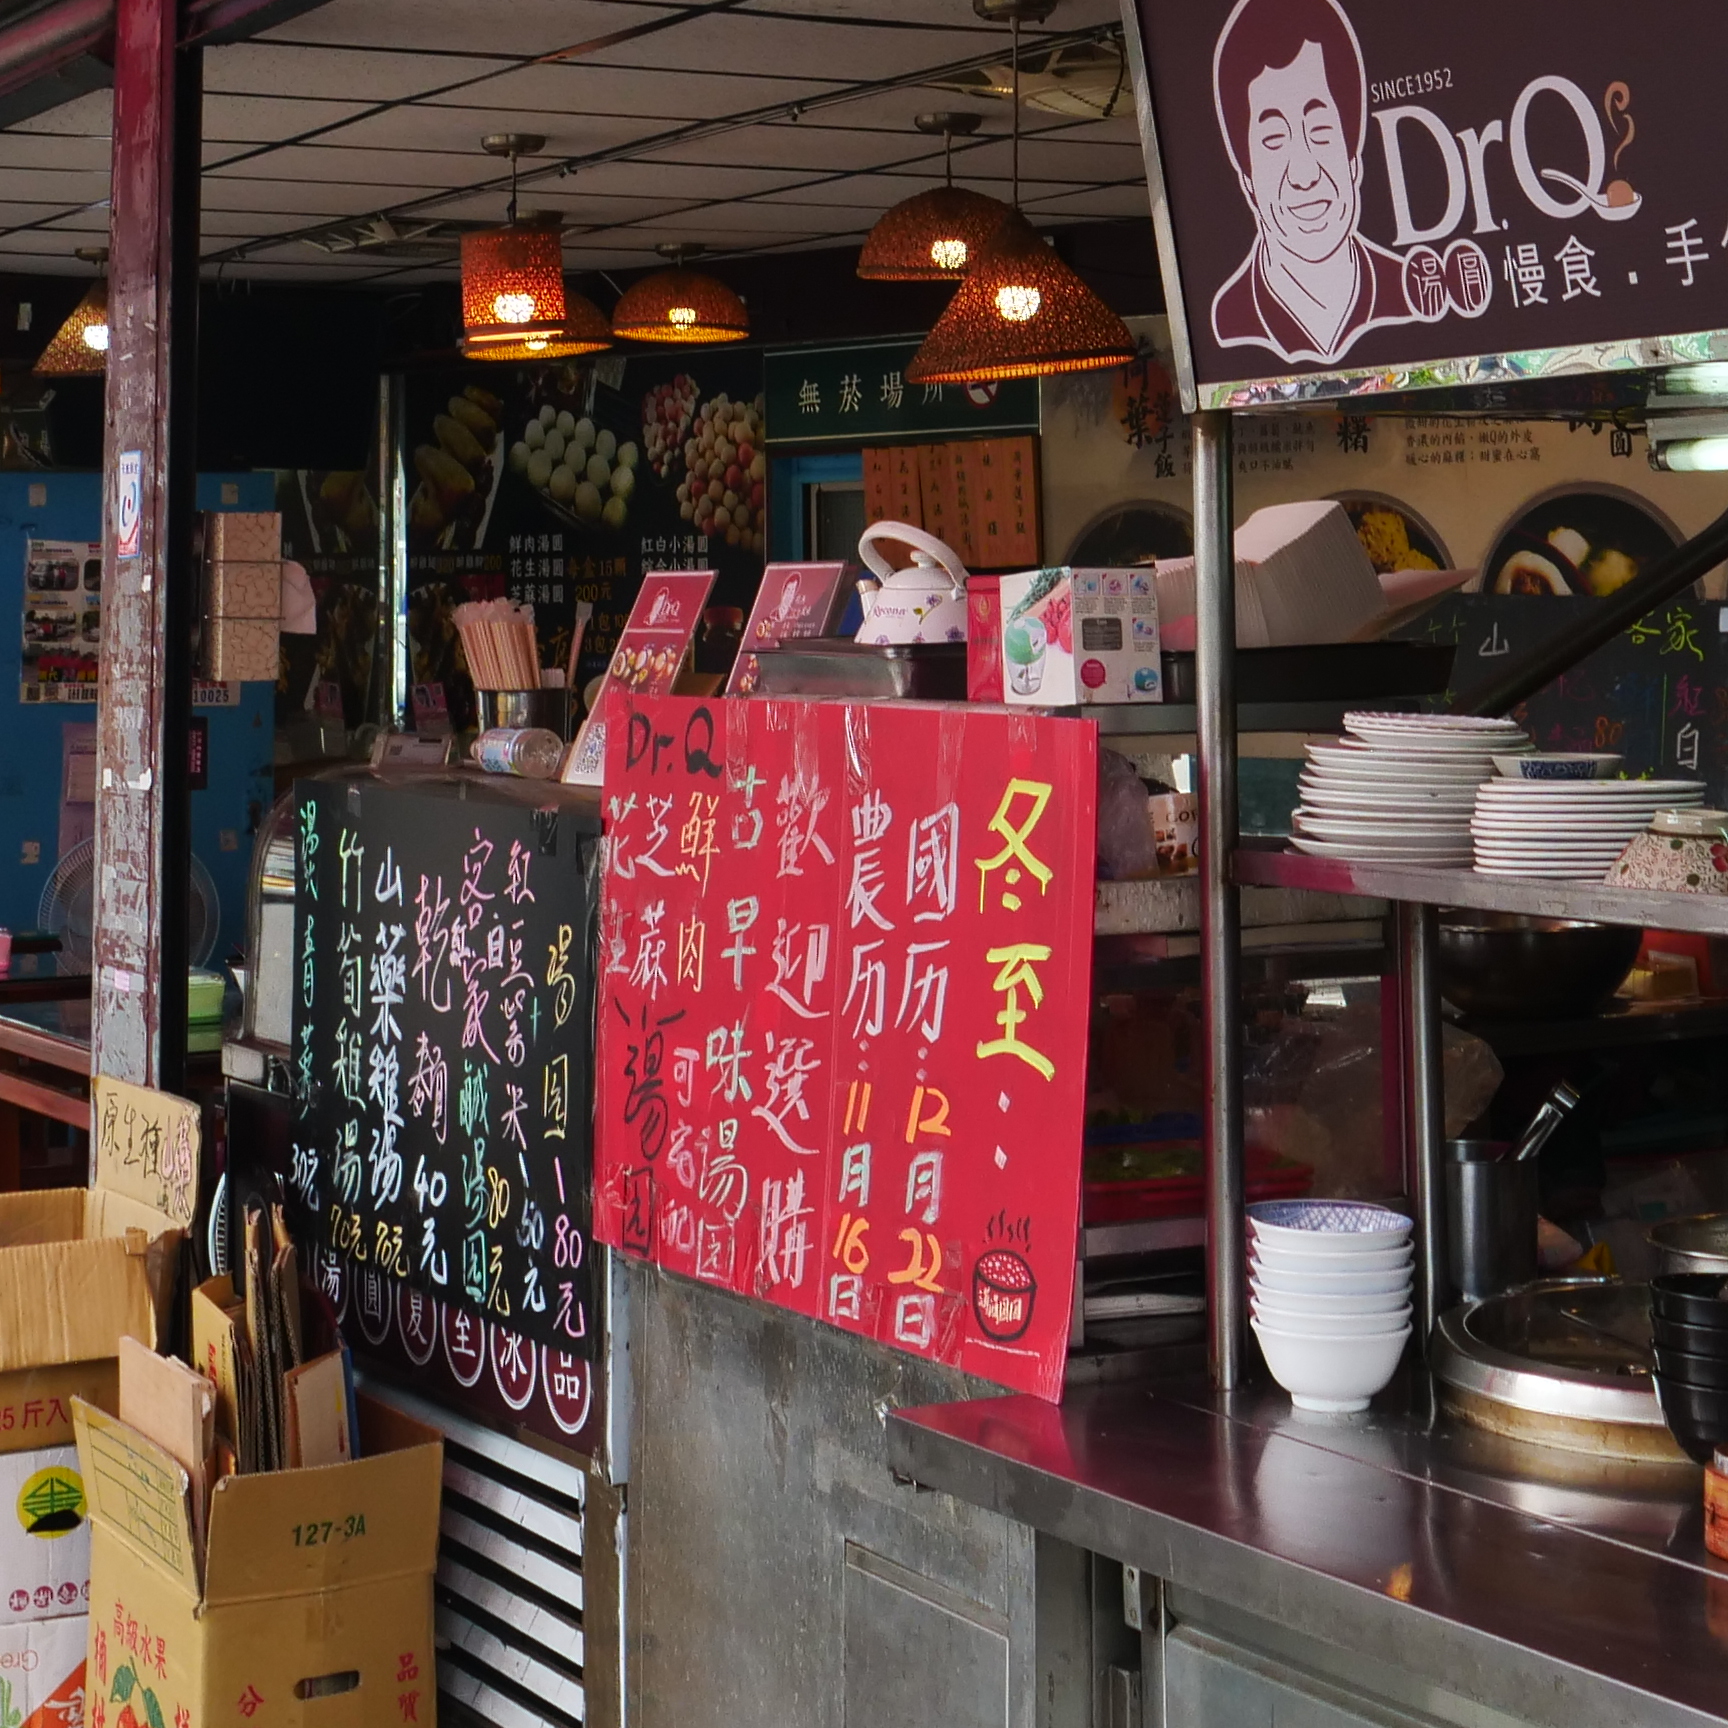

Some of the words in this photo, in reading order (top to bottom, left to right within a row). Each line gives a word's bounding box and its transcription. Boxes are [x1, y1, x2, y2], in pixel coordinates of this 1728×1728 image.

[1371, 67, 1454, 104] SINCE1952
[508, 533, 564, 555] 鮮肉湯圓
[641, 535, 709, 556] 紅白小湯圓
[509, 557, 564, 578] 花生湯圓
[292, 1514, 366, 1548] 127-3A
